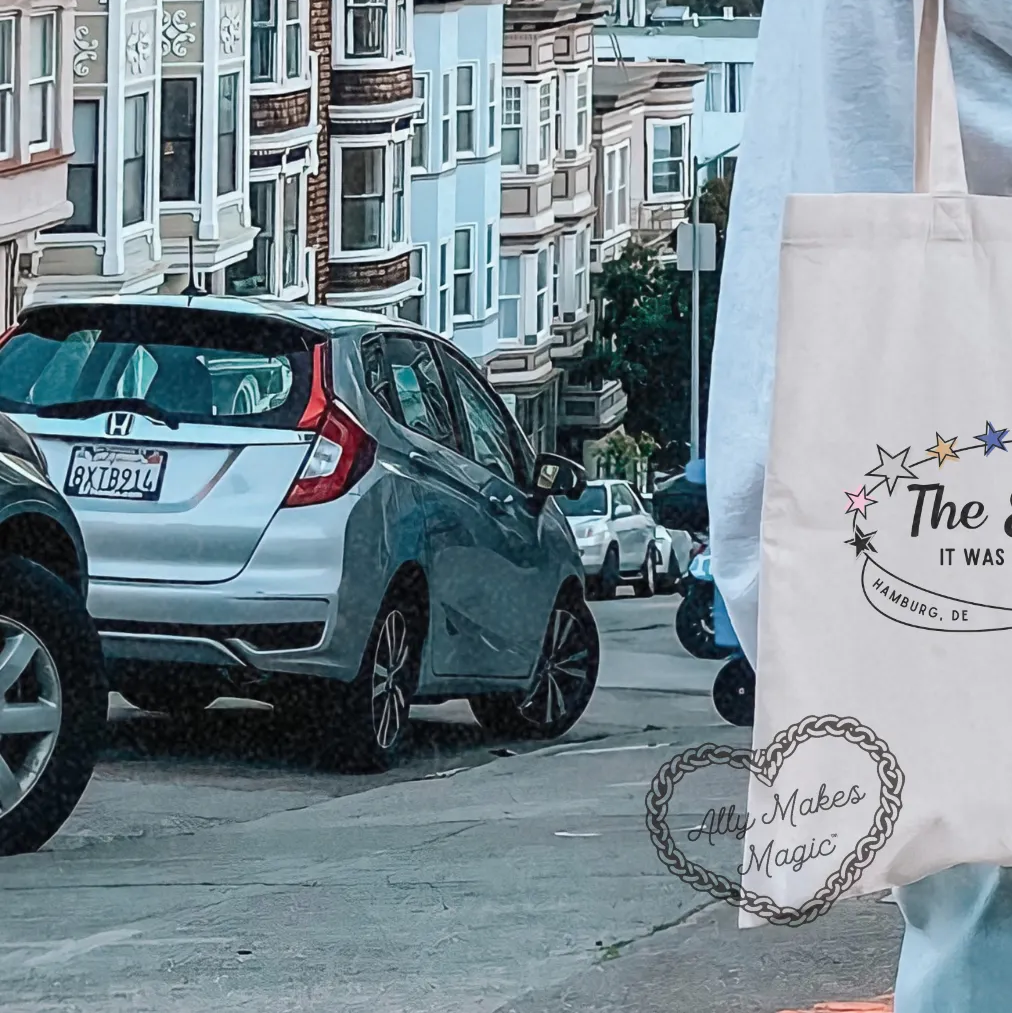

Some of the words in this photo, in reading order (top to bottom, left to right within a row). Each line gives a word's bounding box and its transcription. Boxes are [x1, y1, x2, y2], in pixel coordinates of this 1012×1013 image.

[907, 482, 988, 538] The
[940, 548, 956, 566] IT
[963, 548, 1005, 566] WAS
[872, 578, 943, 622] HAMBURG,
[951, 609, 969, 622] DE
